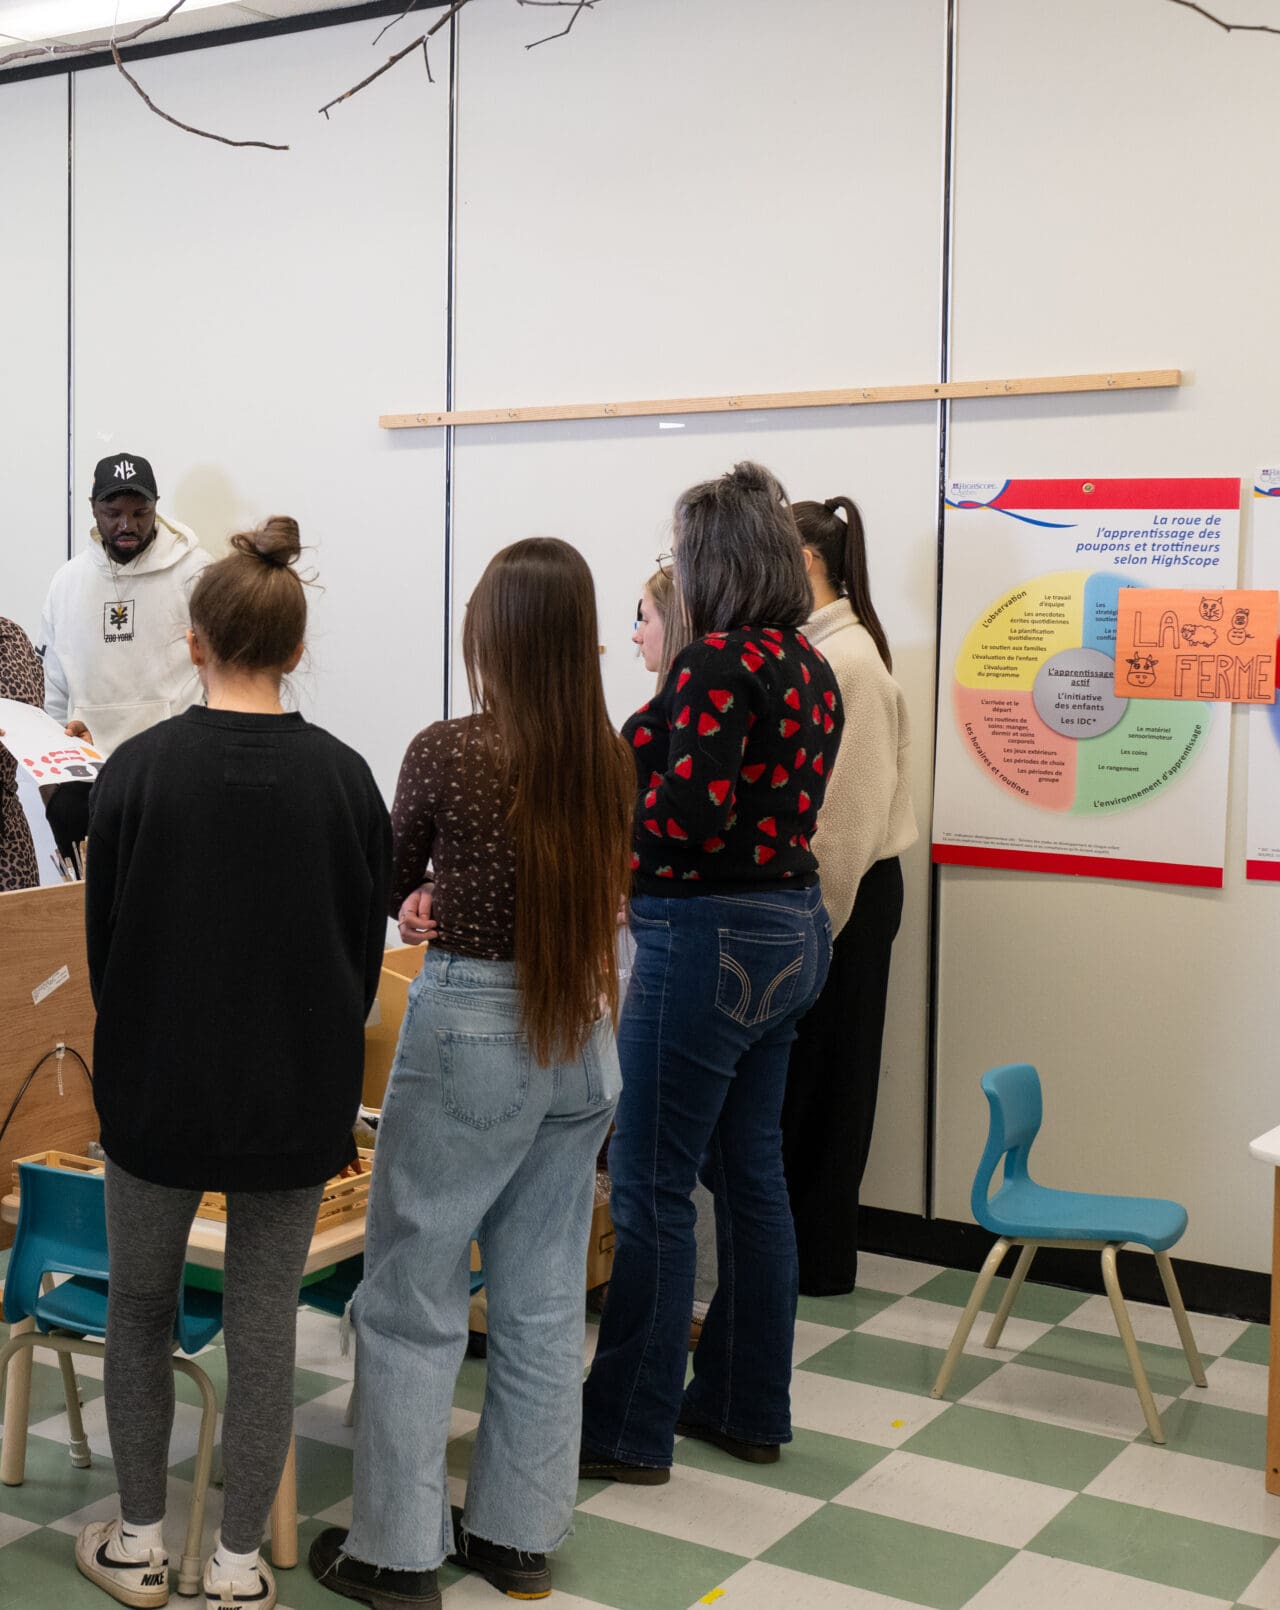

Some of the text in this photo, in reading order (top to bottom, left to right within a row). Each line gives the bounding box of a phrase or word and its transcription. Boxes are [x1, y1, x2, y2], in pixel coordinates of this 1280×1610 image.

[1153, 514, 1222, 526] La roue de
[1096, 528, 1221, 540] l'apprentissage des
[1076, 542, 1220, 553] poupons et trottineurs
[1114, 554, 1220, 568] selon HighScope
[982, 590, 1027, 628] L'observation
[1133, 610, 1180, 649] LA
[1048, 668, 1114, 678] L'apprentissage
[1174, 654, 1272, 699] FERME
[1070, 679, 1090, 687] actif
[1058, 692, 1102, 702] L'initiative
[1072, 703, 1104, 712] enfants
[965, 722, 1030, 796] Les horaires et routines
[1028, 768, 1054, 776] périodes
[1093, 724, 1202, 808] L'environnement d'apprentissage
[140, 1571, 164, 1586] NIKE
